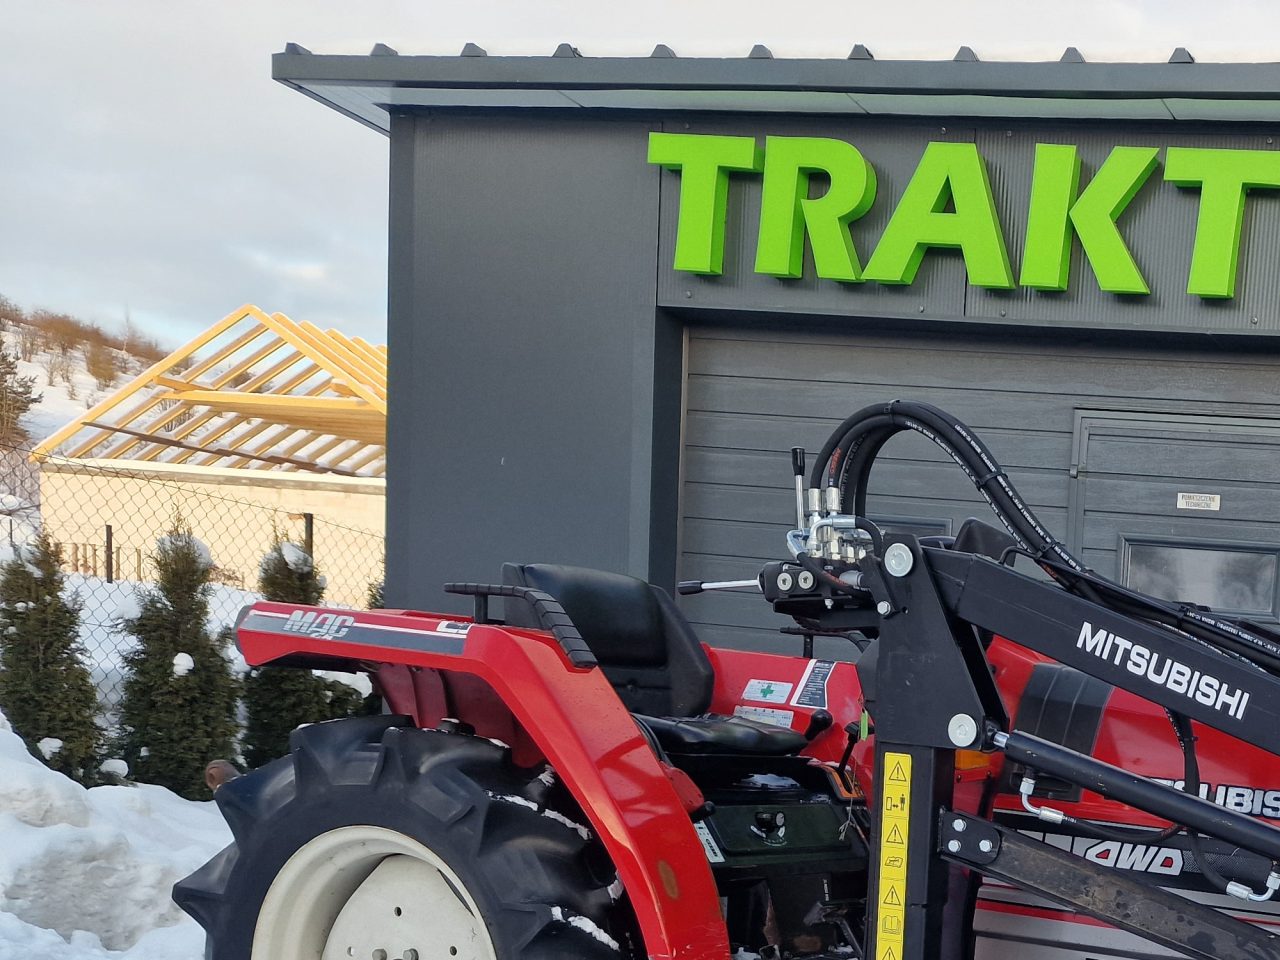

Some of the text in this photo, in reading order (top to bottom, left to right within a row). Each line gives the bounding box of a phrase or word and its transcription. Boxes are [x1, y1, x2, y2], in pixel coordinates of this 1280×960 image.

[282, 609, 355, 637] MAC
[1076, 621, 1250, 720] MITSUBISHI
[1085, 840, 1183, 876] 4WD
